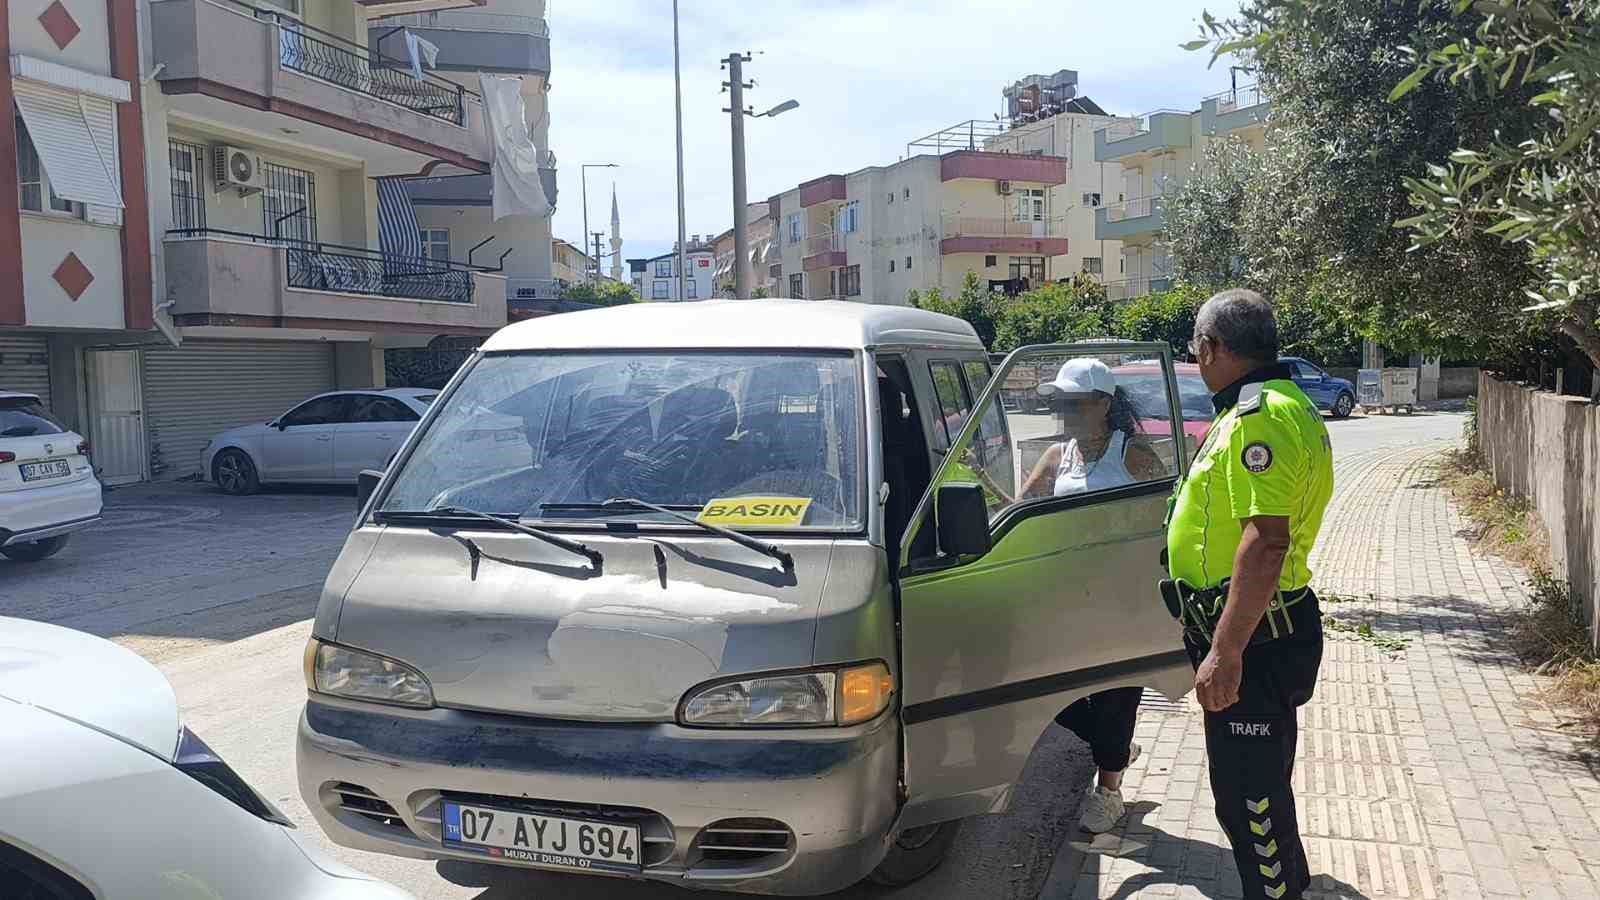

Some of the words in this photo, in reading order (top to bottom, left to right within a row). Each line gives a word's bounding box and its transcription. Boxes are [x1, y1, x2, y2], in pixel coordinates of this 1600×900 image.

[703, 503, 802, 517] BASIN
[462, 809, 494, 841] 07
[513, 817, 567, 851] AYJ
[578, 824, 634, 860] 694
[504, 849, 538, 861] MURAT
[542, 854, 576, 866] DURAN
[579, 860, 591, 868] 07
